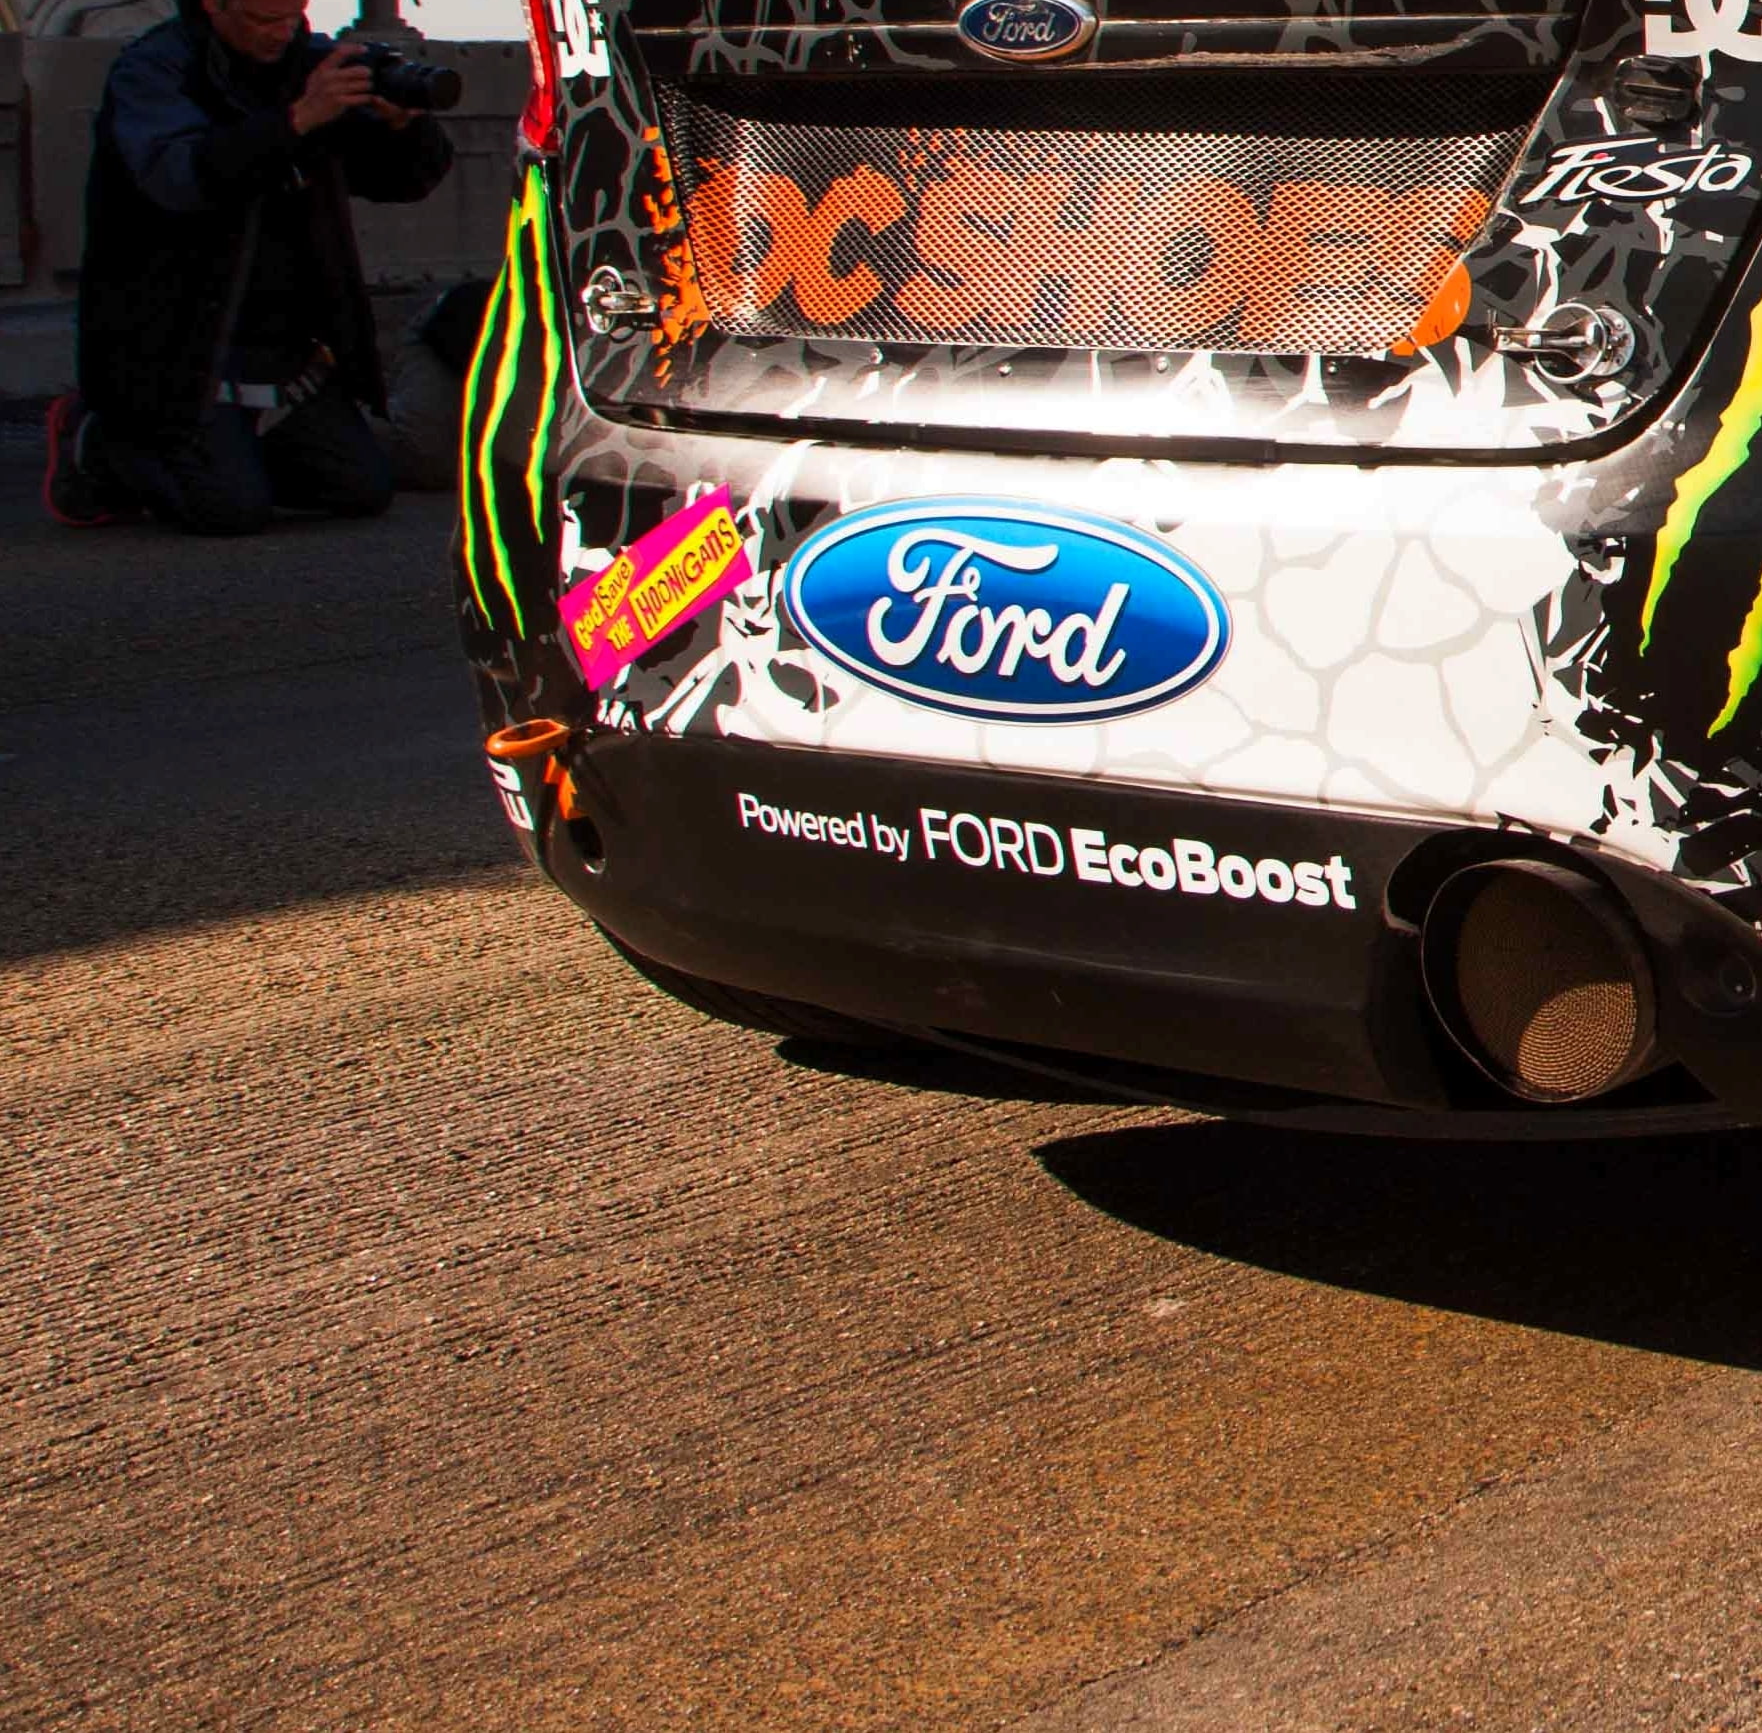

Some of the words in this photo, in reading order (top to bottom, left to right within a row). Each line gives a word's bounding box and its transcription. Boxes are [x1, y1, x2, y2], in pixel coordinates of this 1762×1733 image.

[982, 2, 1056, 43] Ford
[1519, 136, 1753, 206] Fiesta
[597, 561, 632, 610] Save
[866, 526, 1132, 689] Ford
[736, 792, 866, 850] Powered
[876, 810, 911, 863] by
[919, 807, 1065, 878] FORD
[1068, 827, 1358, 911] EcoBoost
